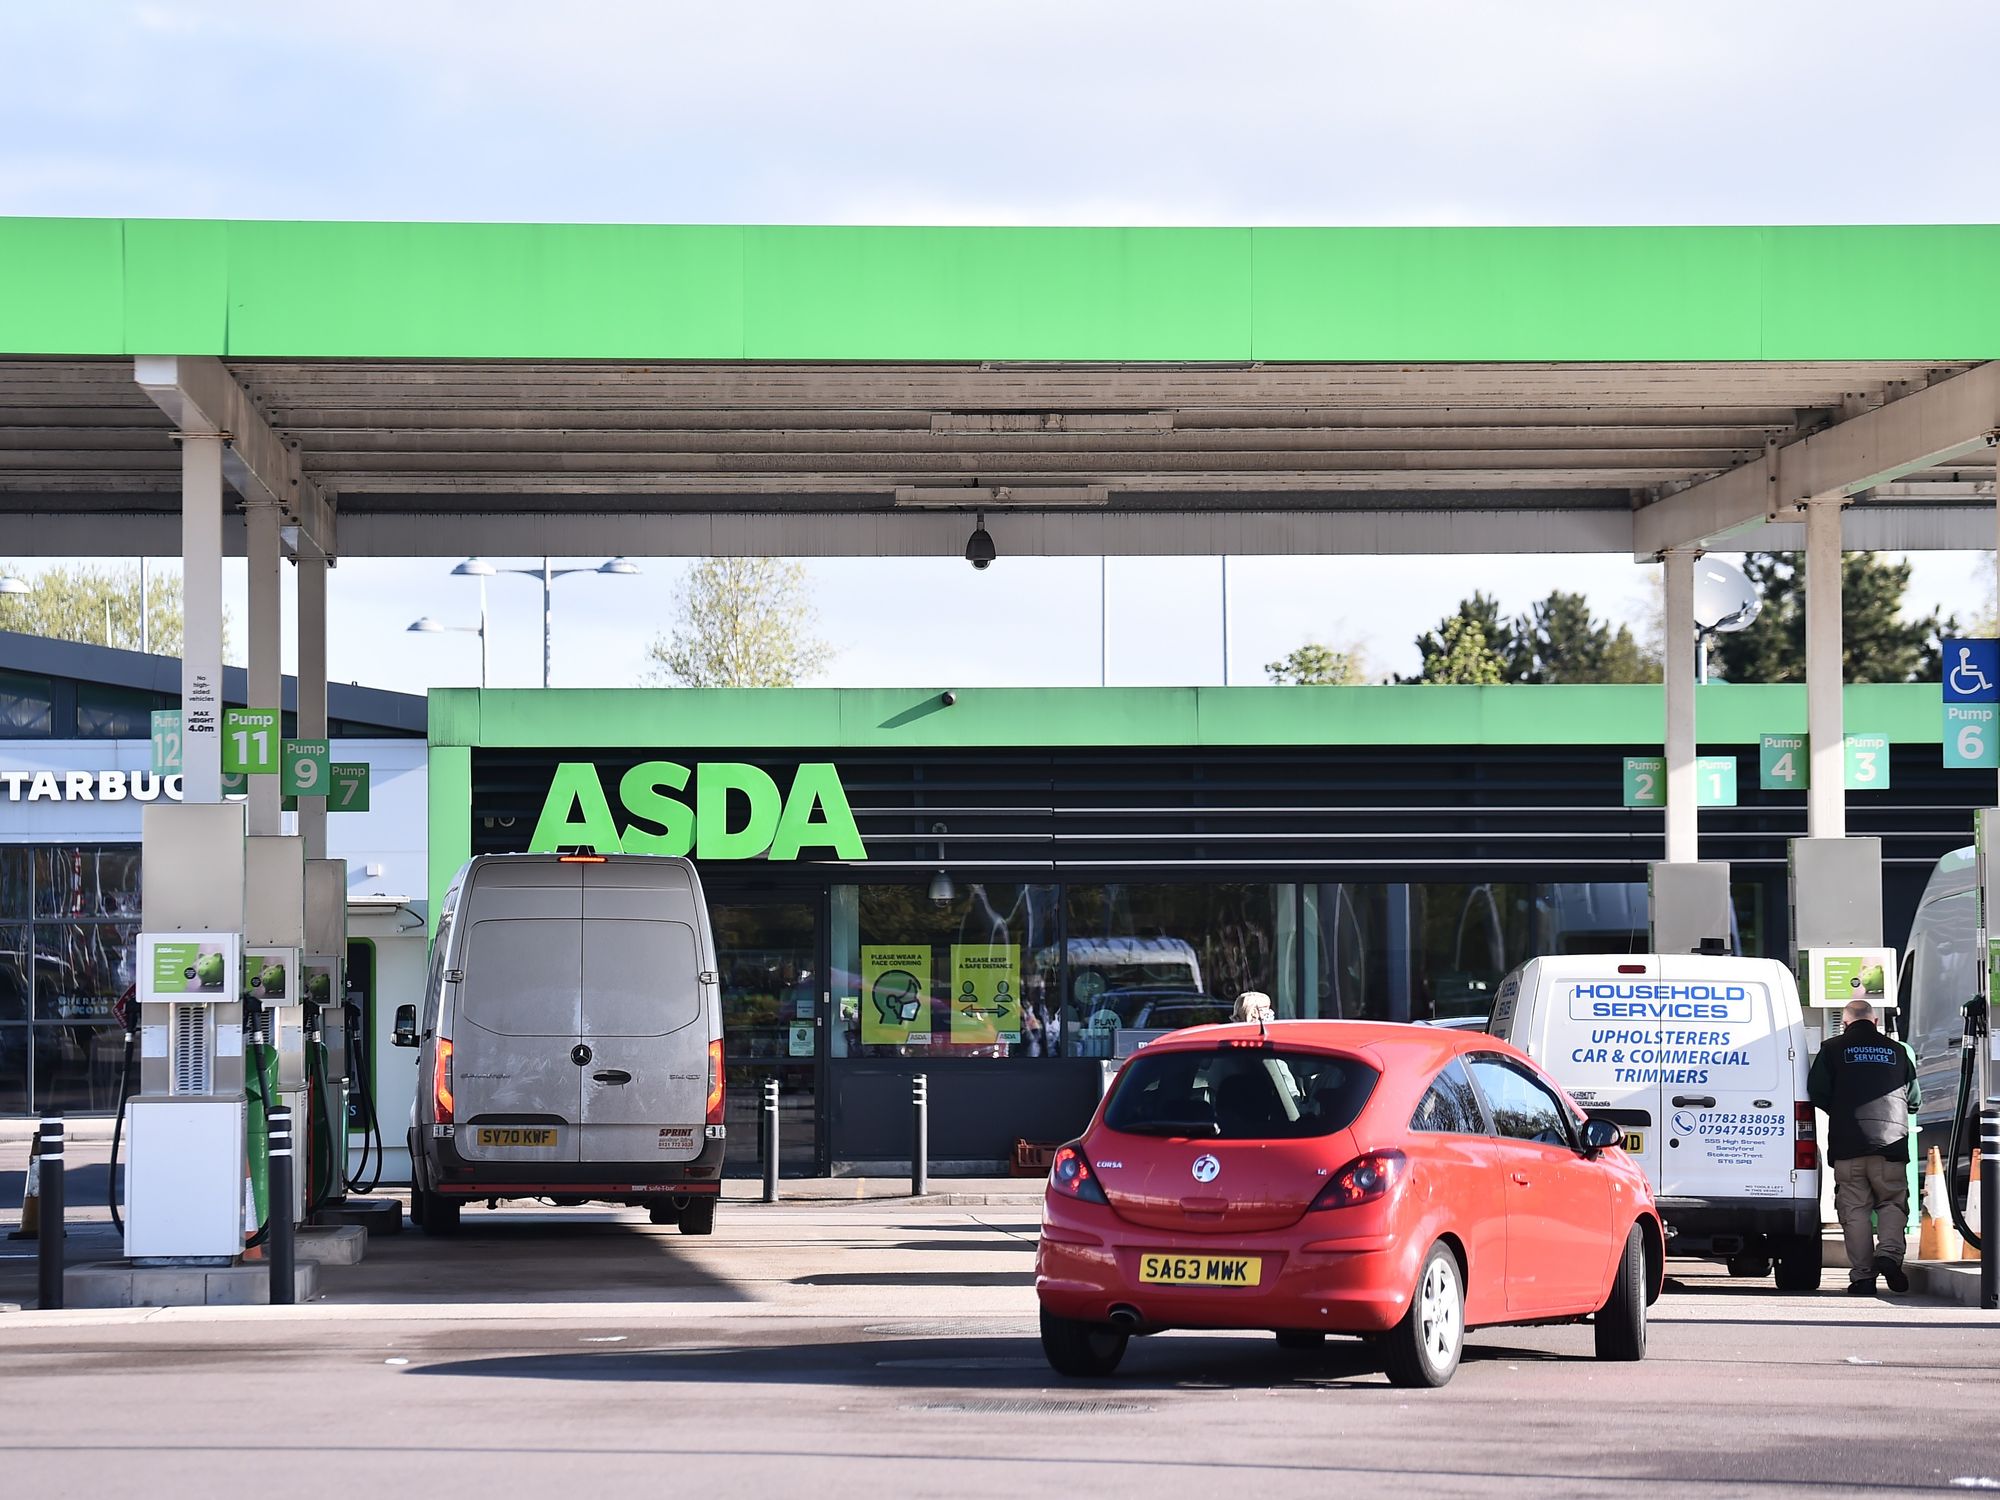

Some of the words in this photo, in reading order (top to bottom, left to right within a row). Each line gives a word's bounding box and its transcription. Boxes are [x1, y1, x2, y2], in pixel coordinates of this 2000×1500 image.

[154, 715, 180, 727] Pump
[227, 712, 273, 727] Pump
[1948, 707, 1993, 721] Pump
[153, 733, 180, 767] 12
[232, 730, 268, 765] 11
[287, 743, 326, 756] Pump
[1764, 737, 1803, 749] Pump
[1846, 737, 1885, 749] Pump
[1956, 725, 1985, 760] 6
[332, 766, 366, 777] Pump
[1627, 760, 1661, 771] Pump
[1697, 759, 1732, 771] Pump
[1770, 752, 1797, 782] 4
[1854, 752, 1877, 782] 3
[294, 758, 318, 788] 9
[1, 770, 248, 801] TARBUC
[339, 779, 359, 805] 7
[1634, 773, 1654, 800] 2
[1707, 773, 1722, 800] 1
[527, 760, 868, 860] ASDA
[1575, 985, 1745, 1000] HOUSEHOLD
[1593, 1003, 1729, 1018] SERVICES
[1591, 1030, 1730, 1045] UPHOLSTERERS
[1572, 1049, 1607, 1062] CAR
[1611, 1050, 1625, 1063] &
[1629, 1050, 1750, 1066] COMMERCIAL
[1847, 1046, 1893, 1056] HOUSEHOLD
[1854, 1054, 1889, 1063] SERVICES
[1614, 1069, 1709, 1084] TRIMMERS
[1699, 1113, 1737, 1123] 01782
[1739, 1114, 1785, 1124] 838058
[484, 1130, 520, 1143] SV70
[523, 1130, 550, 1143] KWF
[658, 1128, 694, 1136] SPRINT
[1699, 1125, 1785, 1136] 07947450973
[1096, 1160, 1123, 1168] CORSA
[1146, 1258, 1200, 1280] SA63
[1206, 1260, 1248, 1281] MWK
